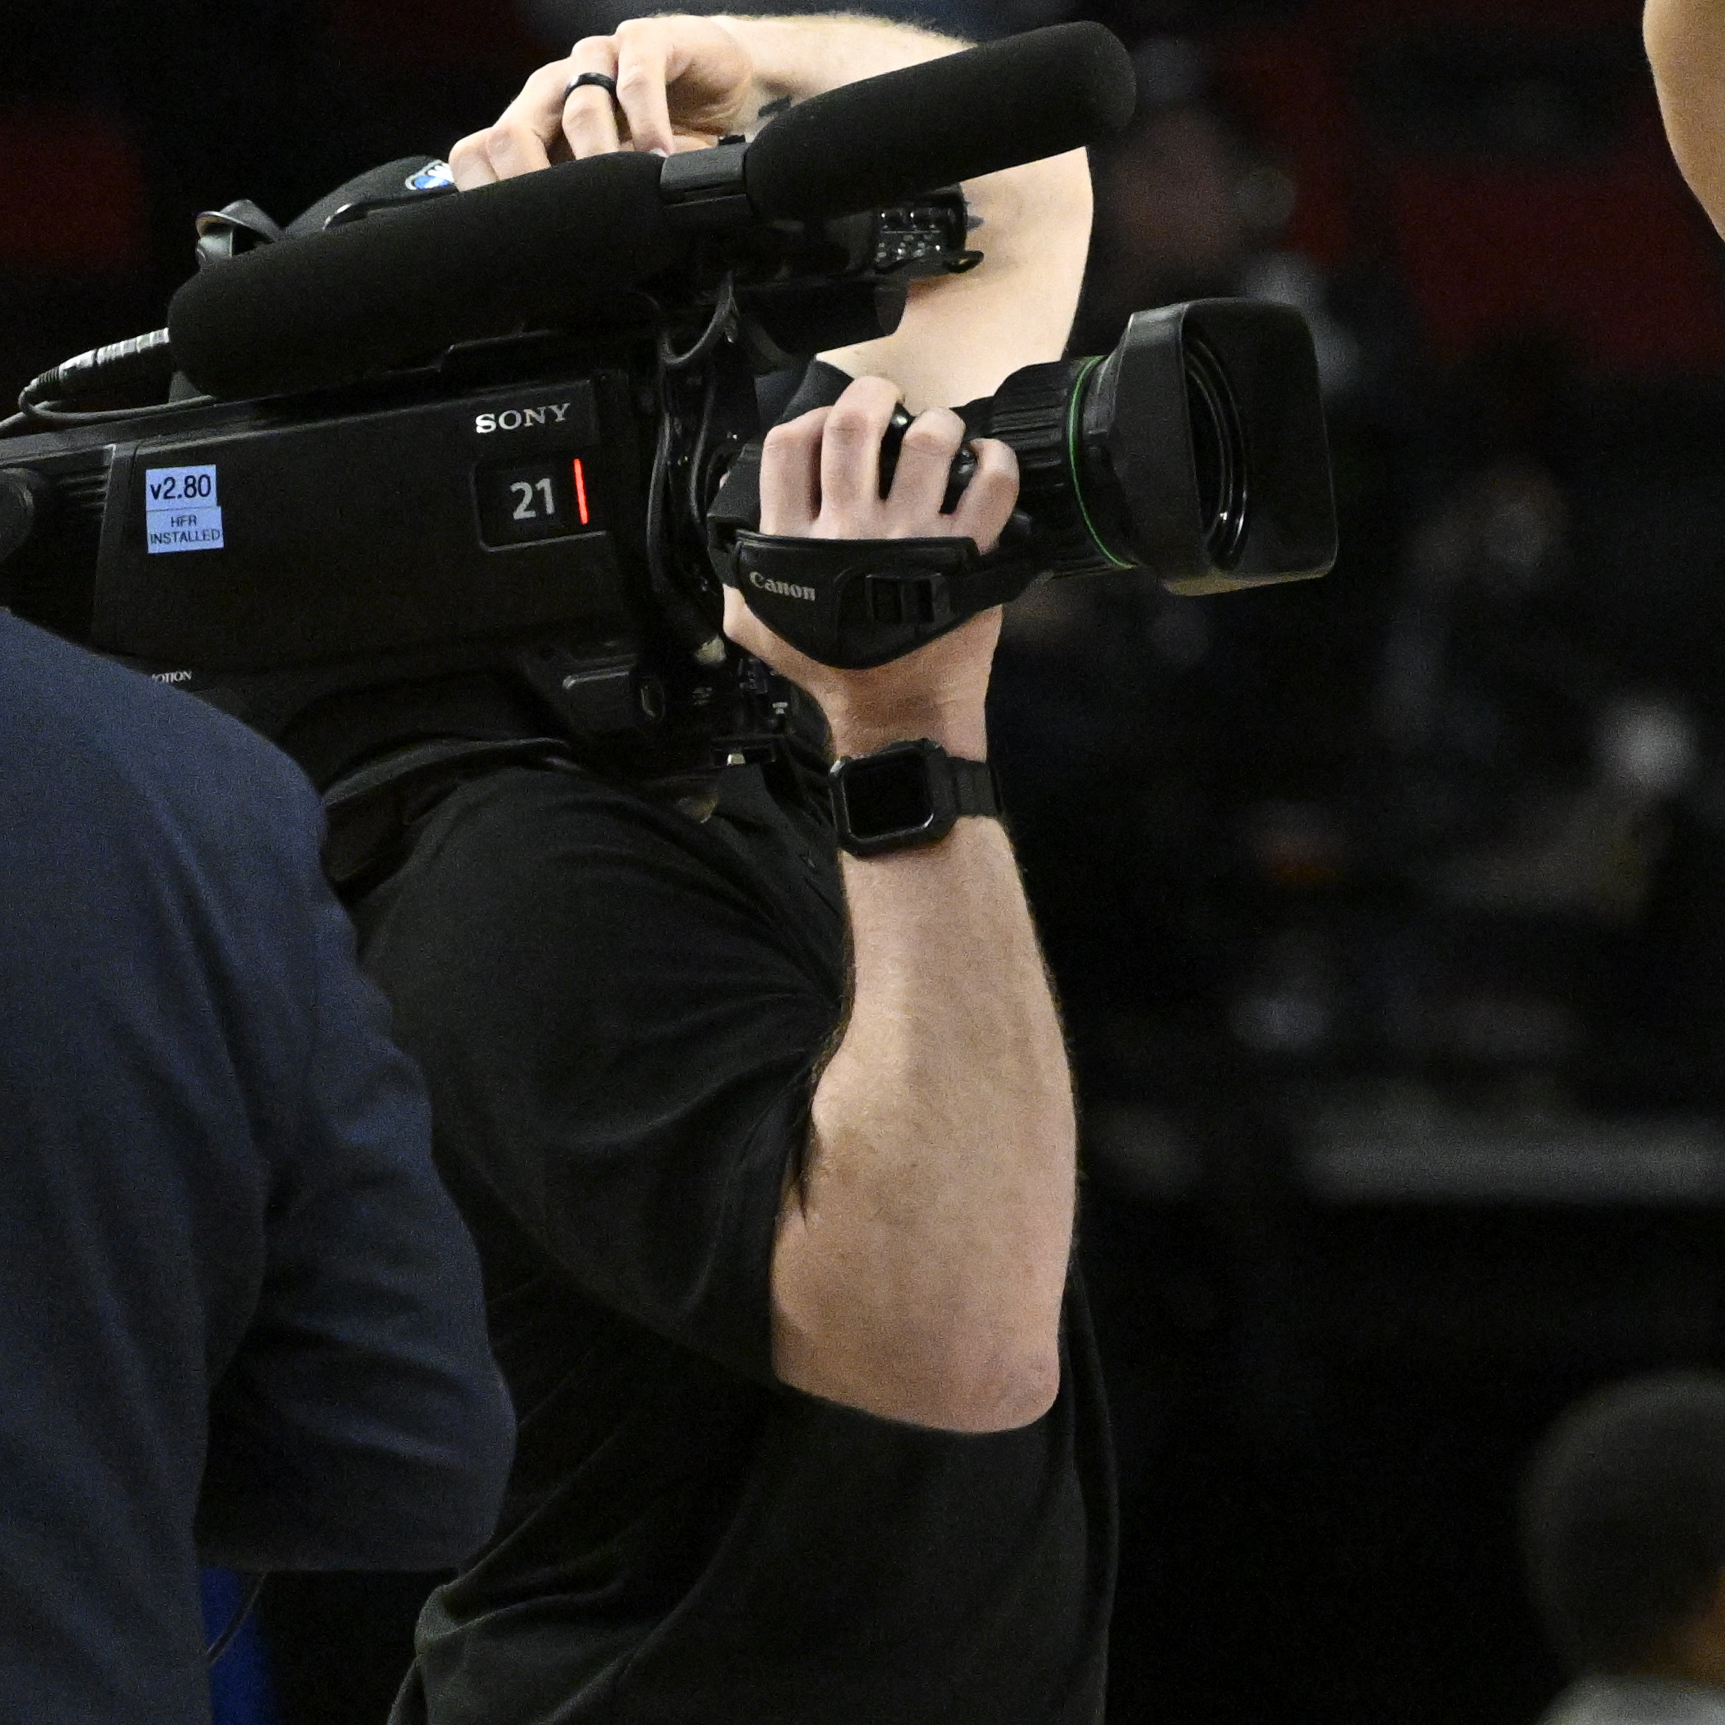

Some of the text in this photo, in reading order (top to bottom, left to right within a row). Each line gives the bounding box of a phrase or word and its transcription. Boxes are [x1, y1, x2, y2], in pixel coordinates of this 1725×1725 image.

[475, 402, 571, 434] SONY
[150, 474, 212, 500] v2.80
[510, 477, 555, 520] 21
[170, 514, 197, 528] HFR
[150, 528, 221, 545] INSTALLED
[749, 571, 816, 601] Canon
